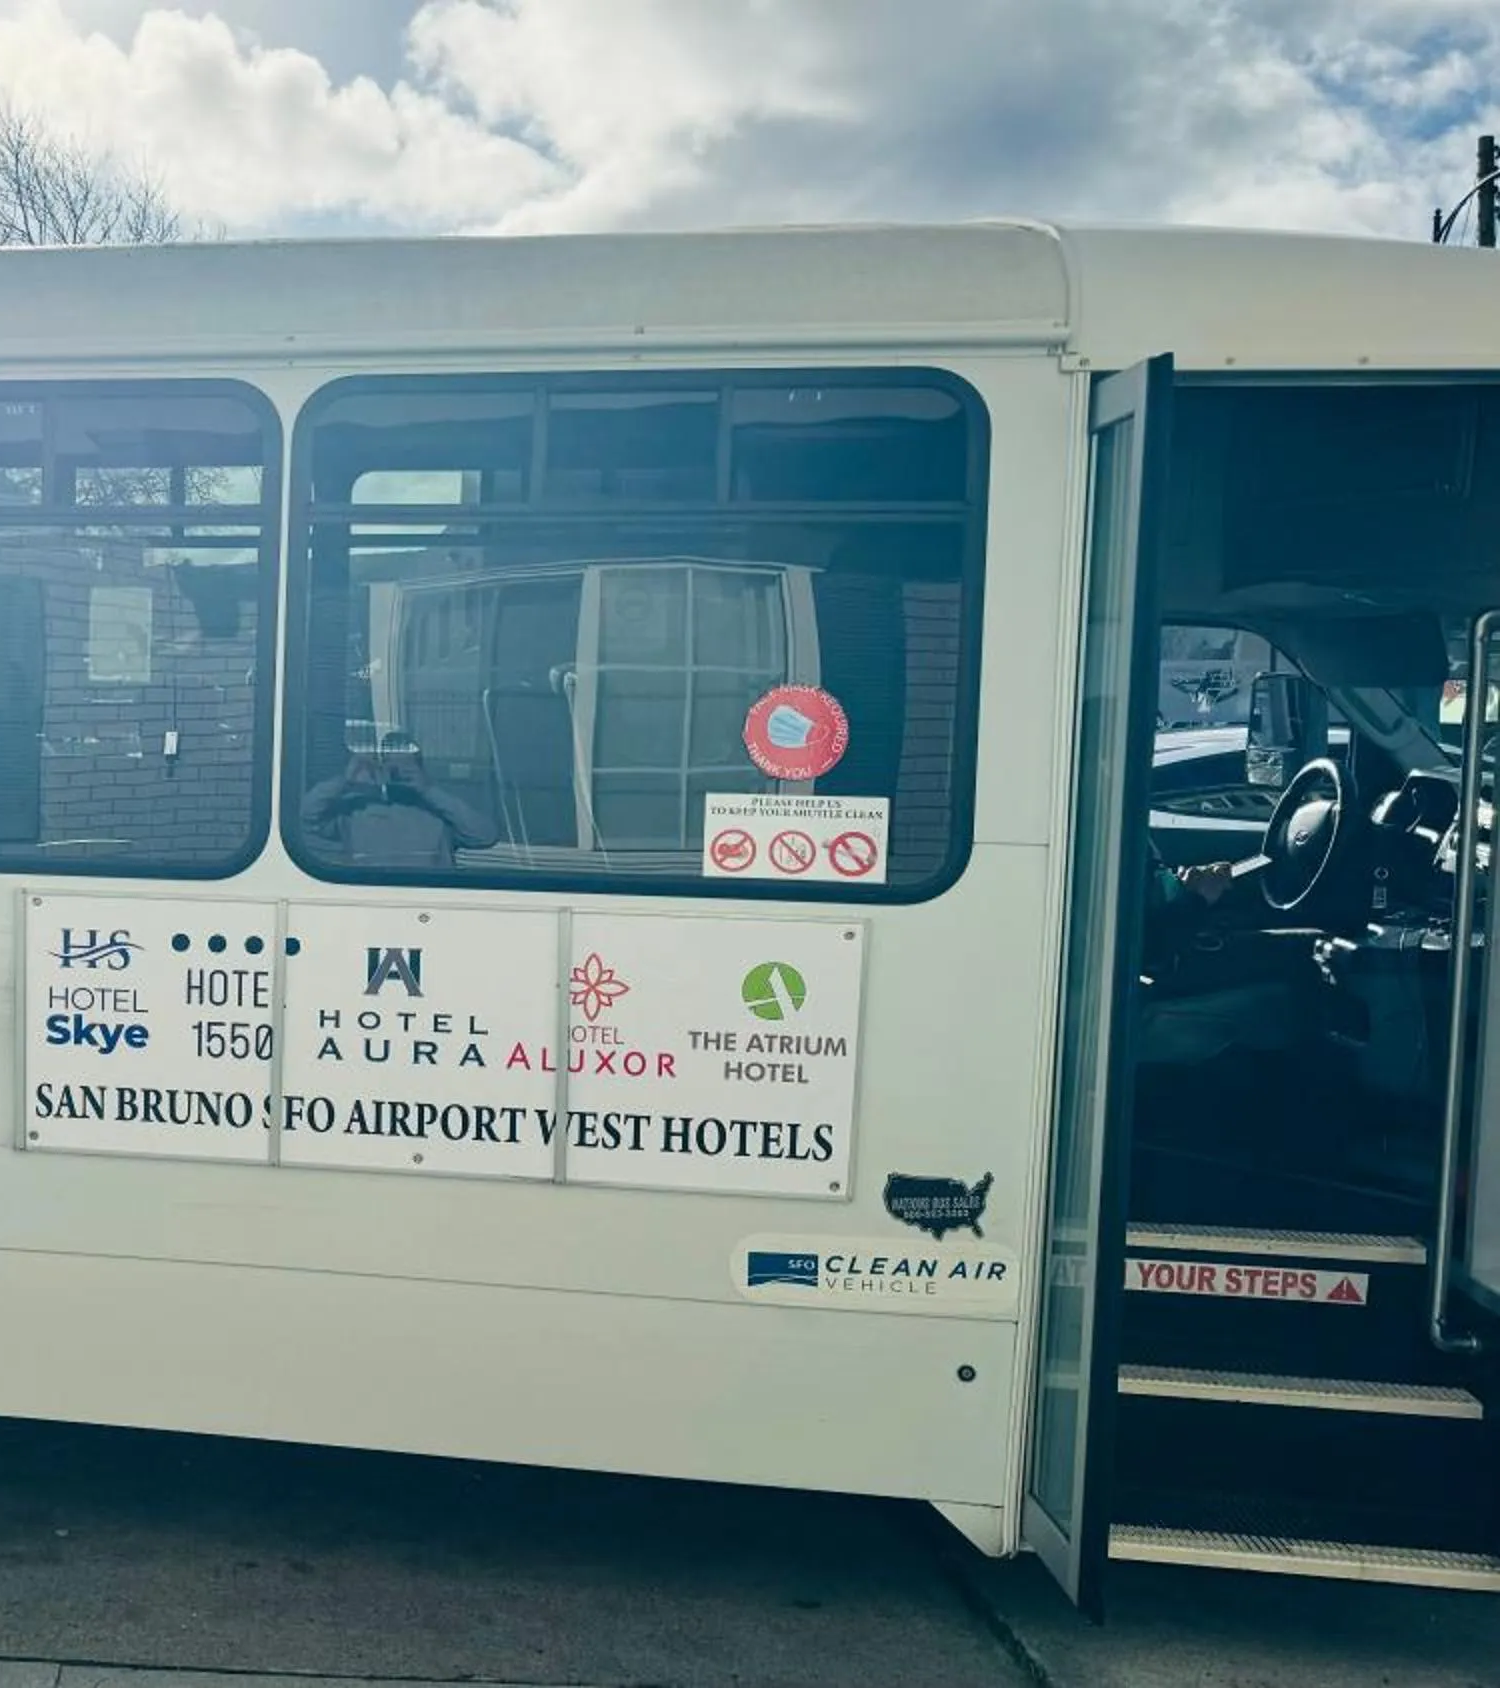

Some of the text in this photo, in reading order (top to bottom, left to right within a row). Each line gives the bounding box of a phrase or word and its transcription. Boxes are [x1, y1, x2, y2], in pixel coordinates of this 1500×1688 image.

[710, 806, 883, 820] TO KEEP YOUR SHUTTLE CLEAN
[751, 796, 792, 808] PLEASE
[794, 798, 826, 809] HELP
[48, 985, 149, 1013] HOTEL
[186, 968, 270, 1009] HOTE
[45, 1013, 150, 1055] Skye
[318, 1009, 489, 1035] HOTEL
[566, 1024, 625, 1045] OTEL
[191, 1020, 275, 1061] 1550
[316, 1036, 487, 1068] AURA
[688, 1030, 848, 1058] THE ATRIUM
[506, 1041, 677, 1078] ALUXOR
[723, 1061, 810, 1084] HOTEL
[35, 1082, 107, 1121] SAN
[114, 1086, 253, 1129] BRUNO
[344, 1098, 527, 1144] AIRPORT
[534, 1107, 652, 1151] WEST
[660, 1115, 834, 1163] HOTELS
[787, 1258, 816, 1270] SFO
[825, 1255, 1008, 1281] CLEAN AIR
[826, 1277, 938, 1295] VEHICLE
[1137, 1262, 1218, 1294] YOUR
[1225, 1268, 1318, 1299] STEPS
